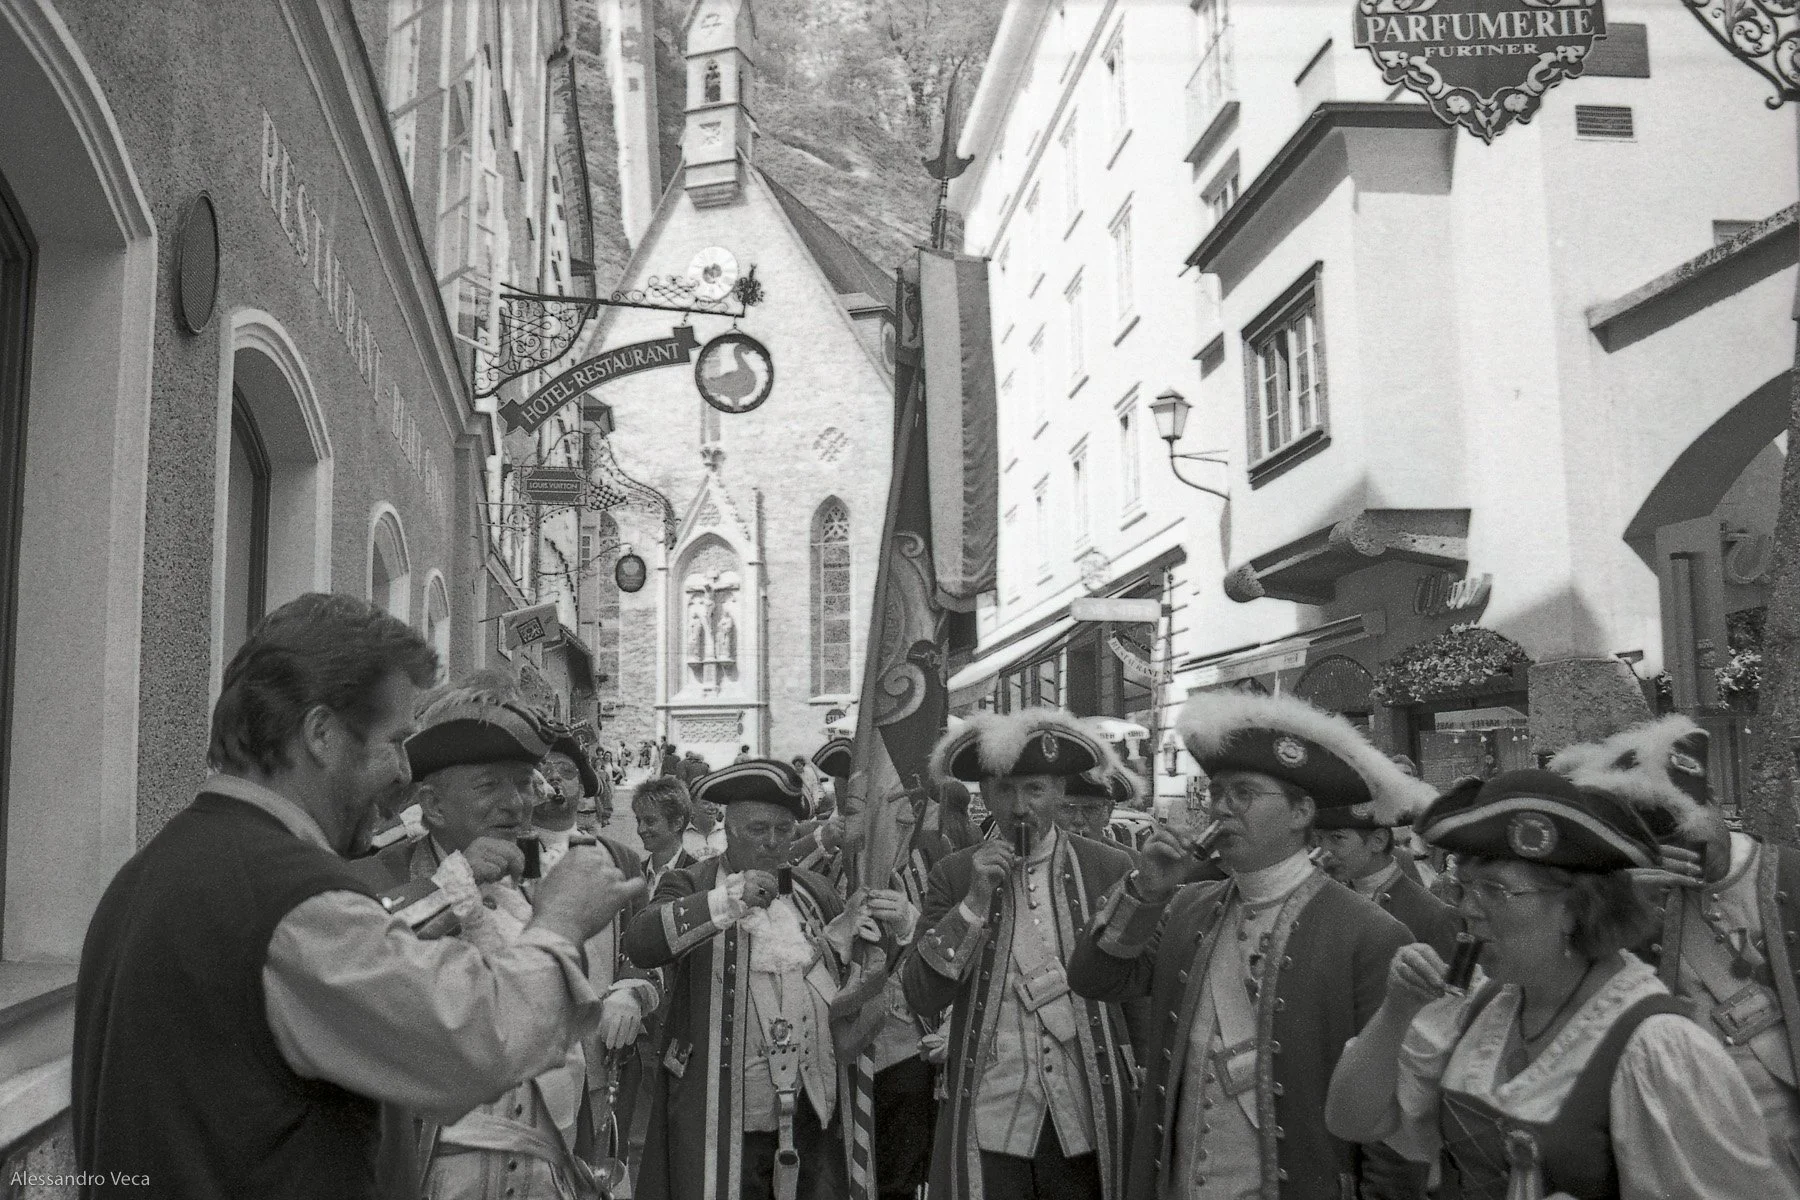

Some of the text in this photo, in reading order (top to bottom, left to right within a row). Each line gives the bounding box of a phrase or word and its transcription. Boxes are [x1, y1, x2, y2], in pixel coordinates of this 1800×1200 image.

[1363, 8, 1595, 44] PARFUMERIE
[1424, 43, 1541, 58] FURTNER
[260, 107, 382, 403] RESTAURANT
[520, 343, 680, 425] HOTEL-RESTAURANT
[1109, 640, 1158, 678] RESTAURANT
